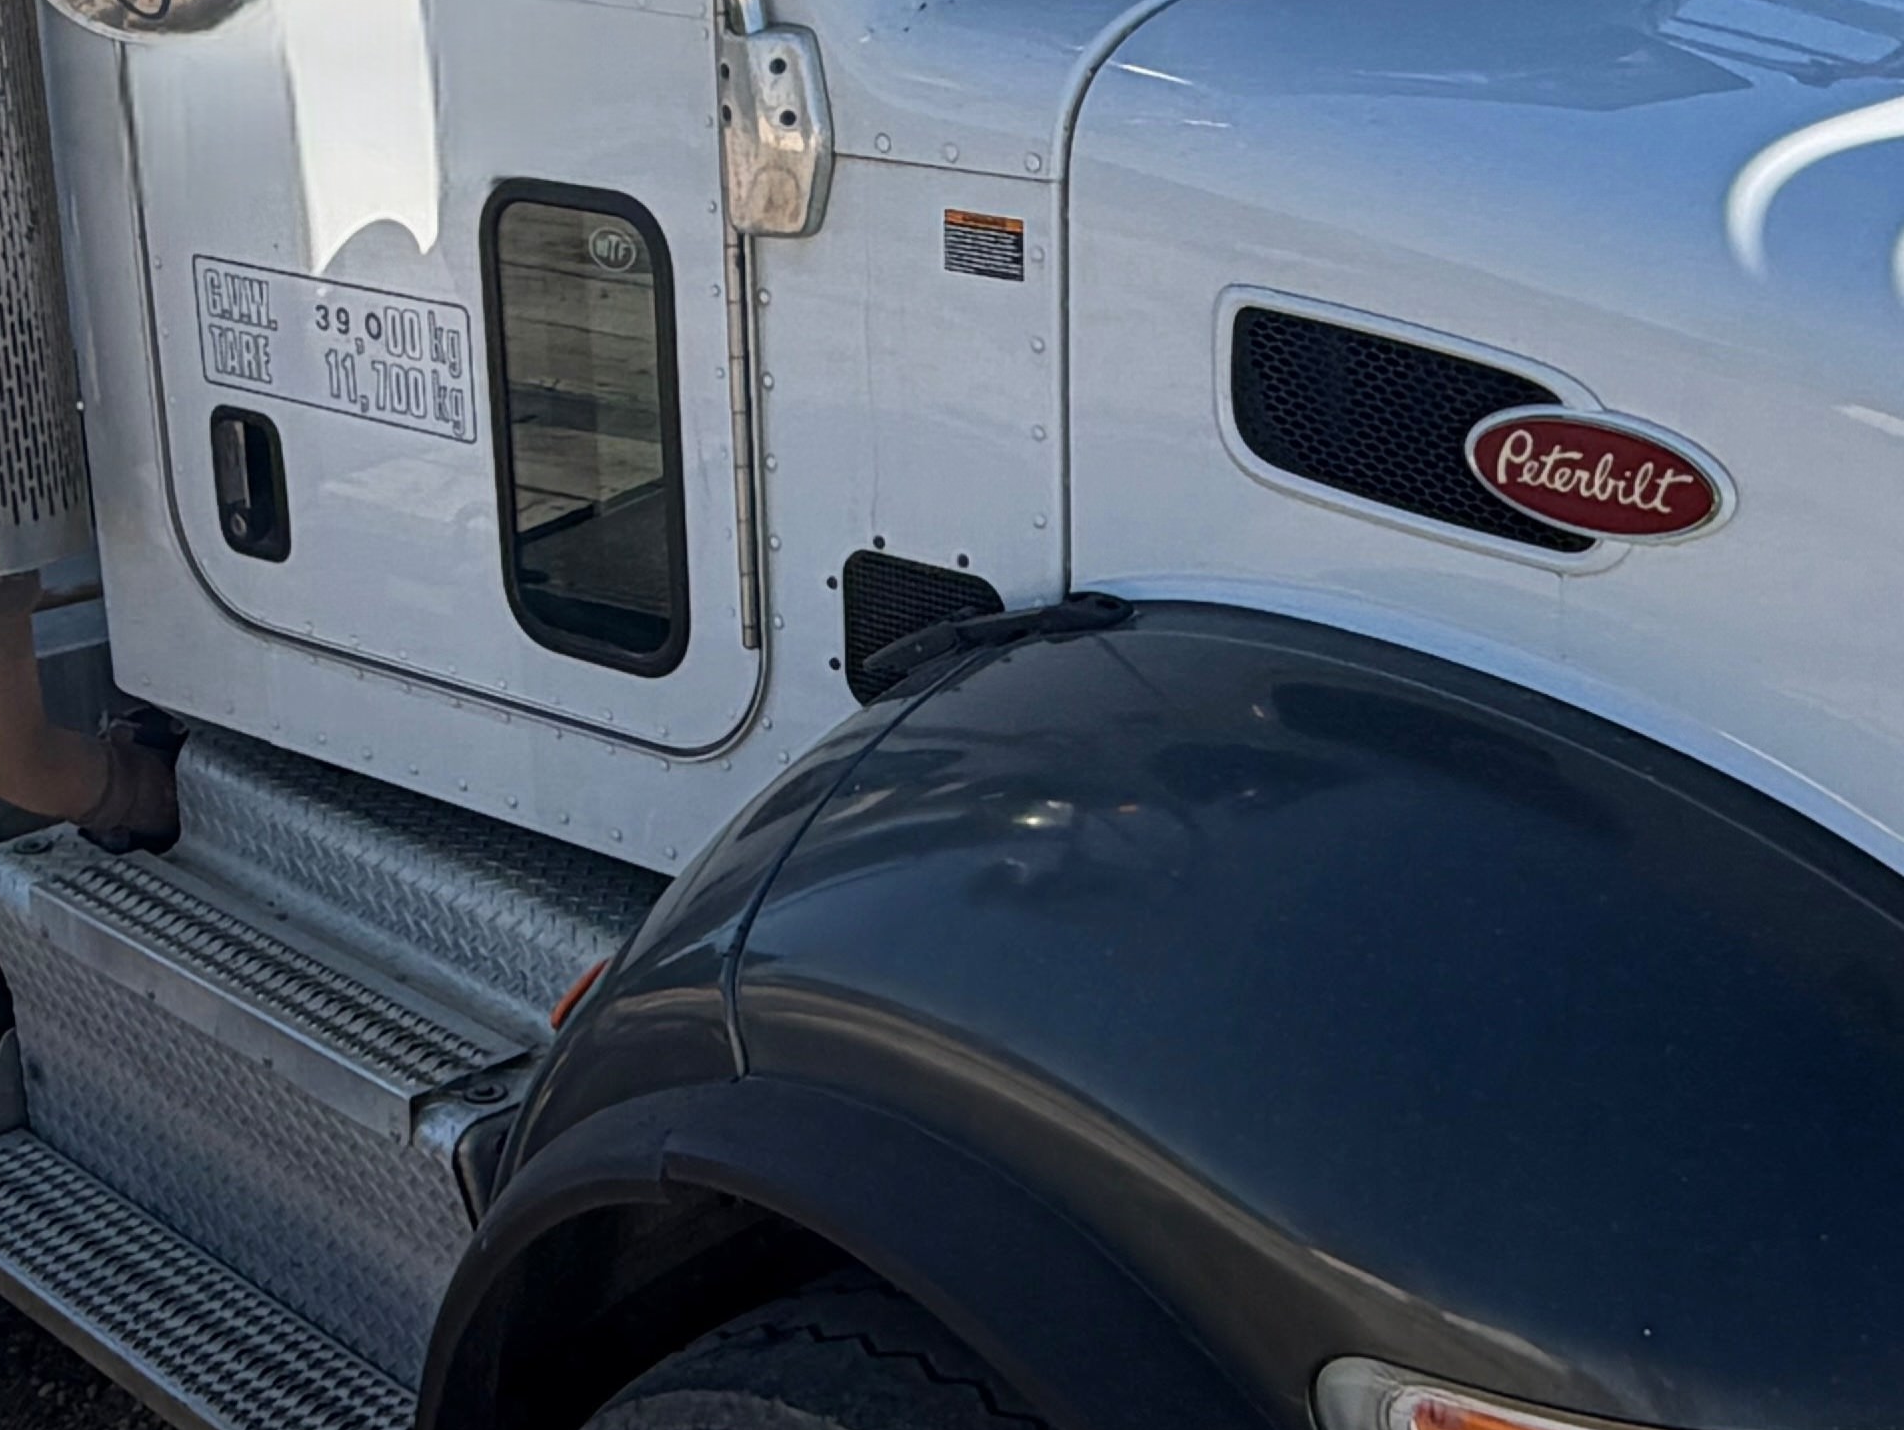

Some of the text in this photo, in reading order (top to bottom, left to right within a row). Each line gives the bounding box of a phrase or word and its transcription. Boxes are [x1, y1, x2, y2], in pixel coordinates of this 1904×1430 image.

[204, 269, 278, 331] G.V.W.
[428, 310, 462, 377] kg
[208, 325, 466, 437] TARE 11,700 kg
[1497, 429, 1693, 513] Peterbilt
